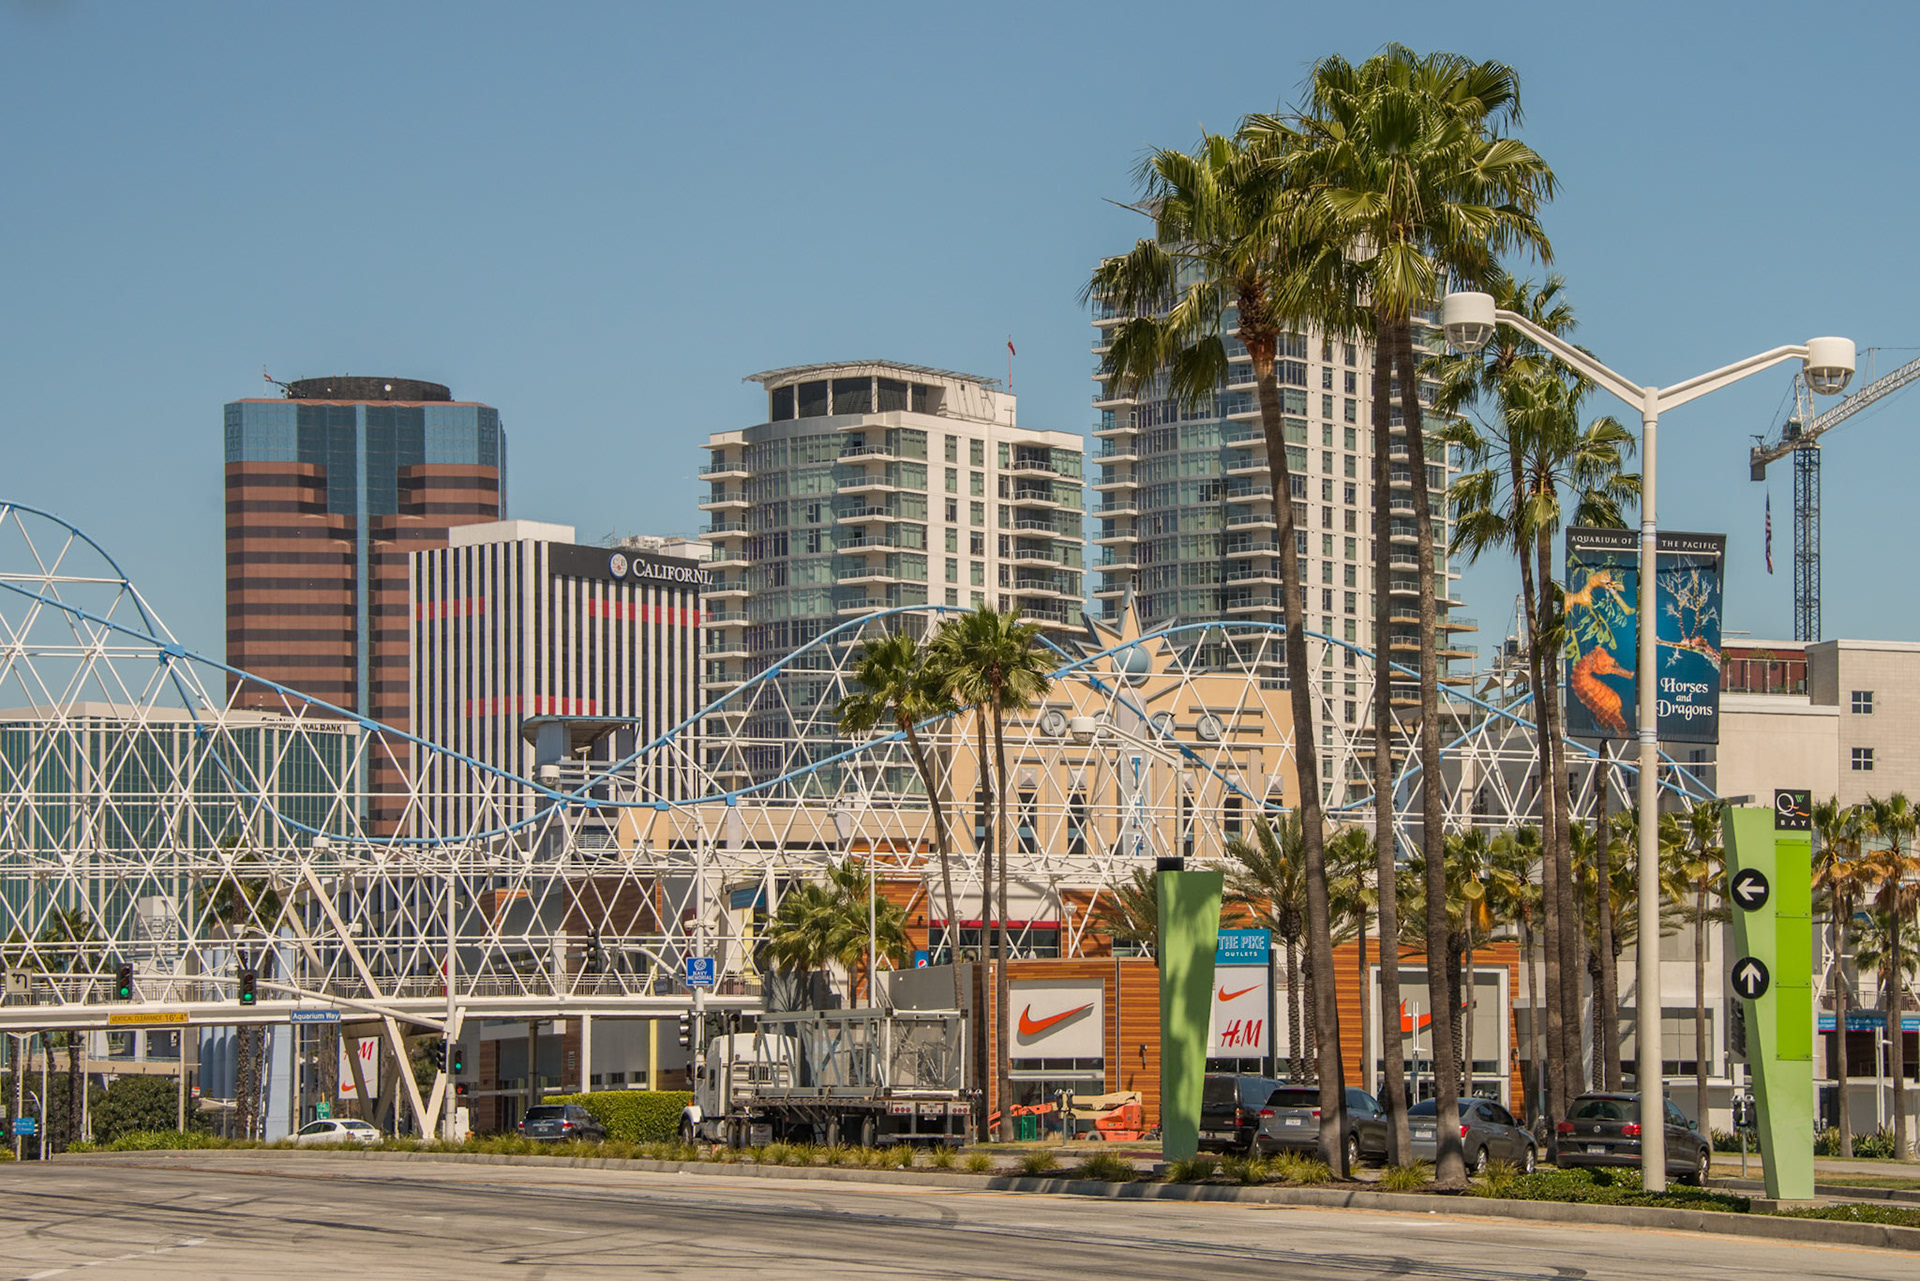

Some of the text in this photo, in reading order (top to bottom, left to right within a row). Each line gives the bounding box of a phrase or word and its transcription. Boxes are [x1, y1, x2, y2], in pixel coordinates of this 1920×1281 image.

[1571, 535, 1718, 550] AQUARIUM OF THE PACIFIC
[1660, 677, 1709, 694] Horses
[1675, 692, 1693, 702] and
[1656, 699, 1713, 721] Dragons
[1780, 819, 1807, 827] BAY
[1217, 935, 1265, 950] THE PIKE
[293, 1012, 340, 1021] Aquarium Way
[1221, 1019, 1263, 1048] H&M
